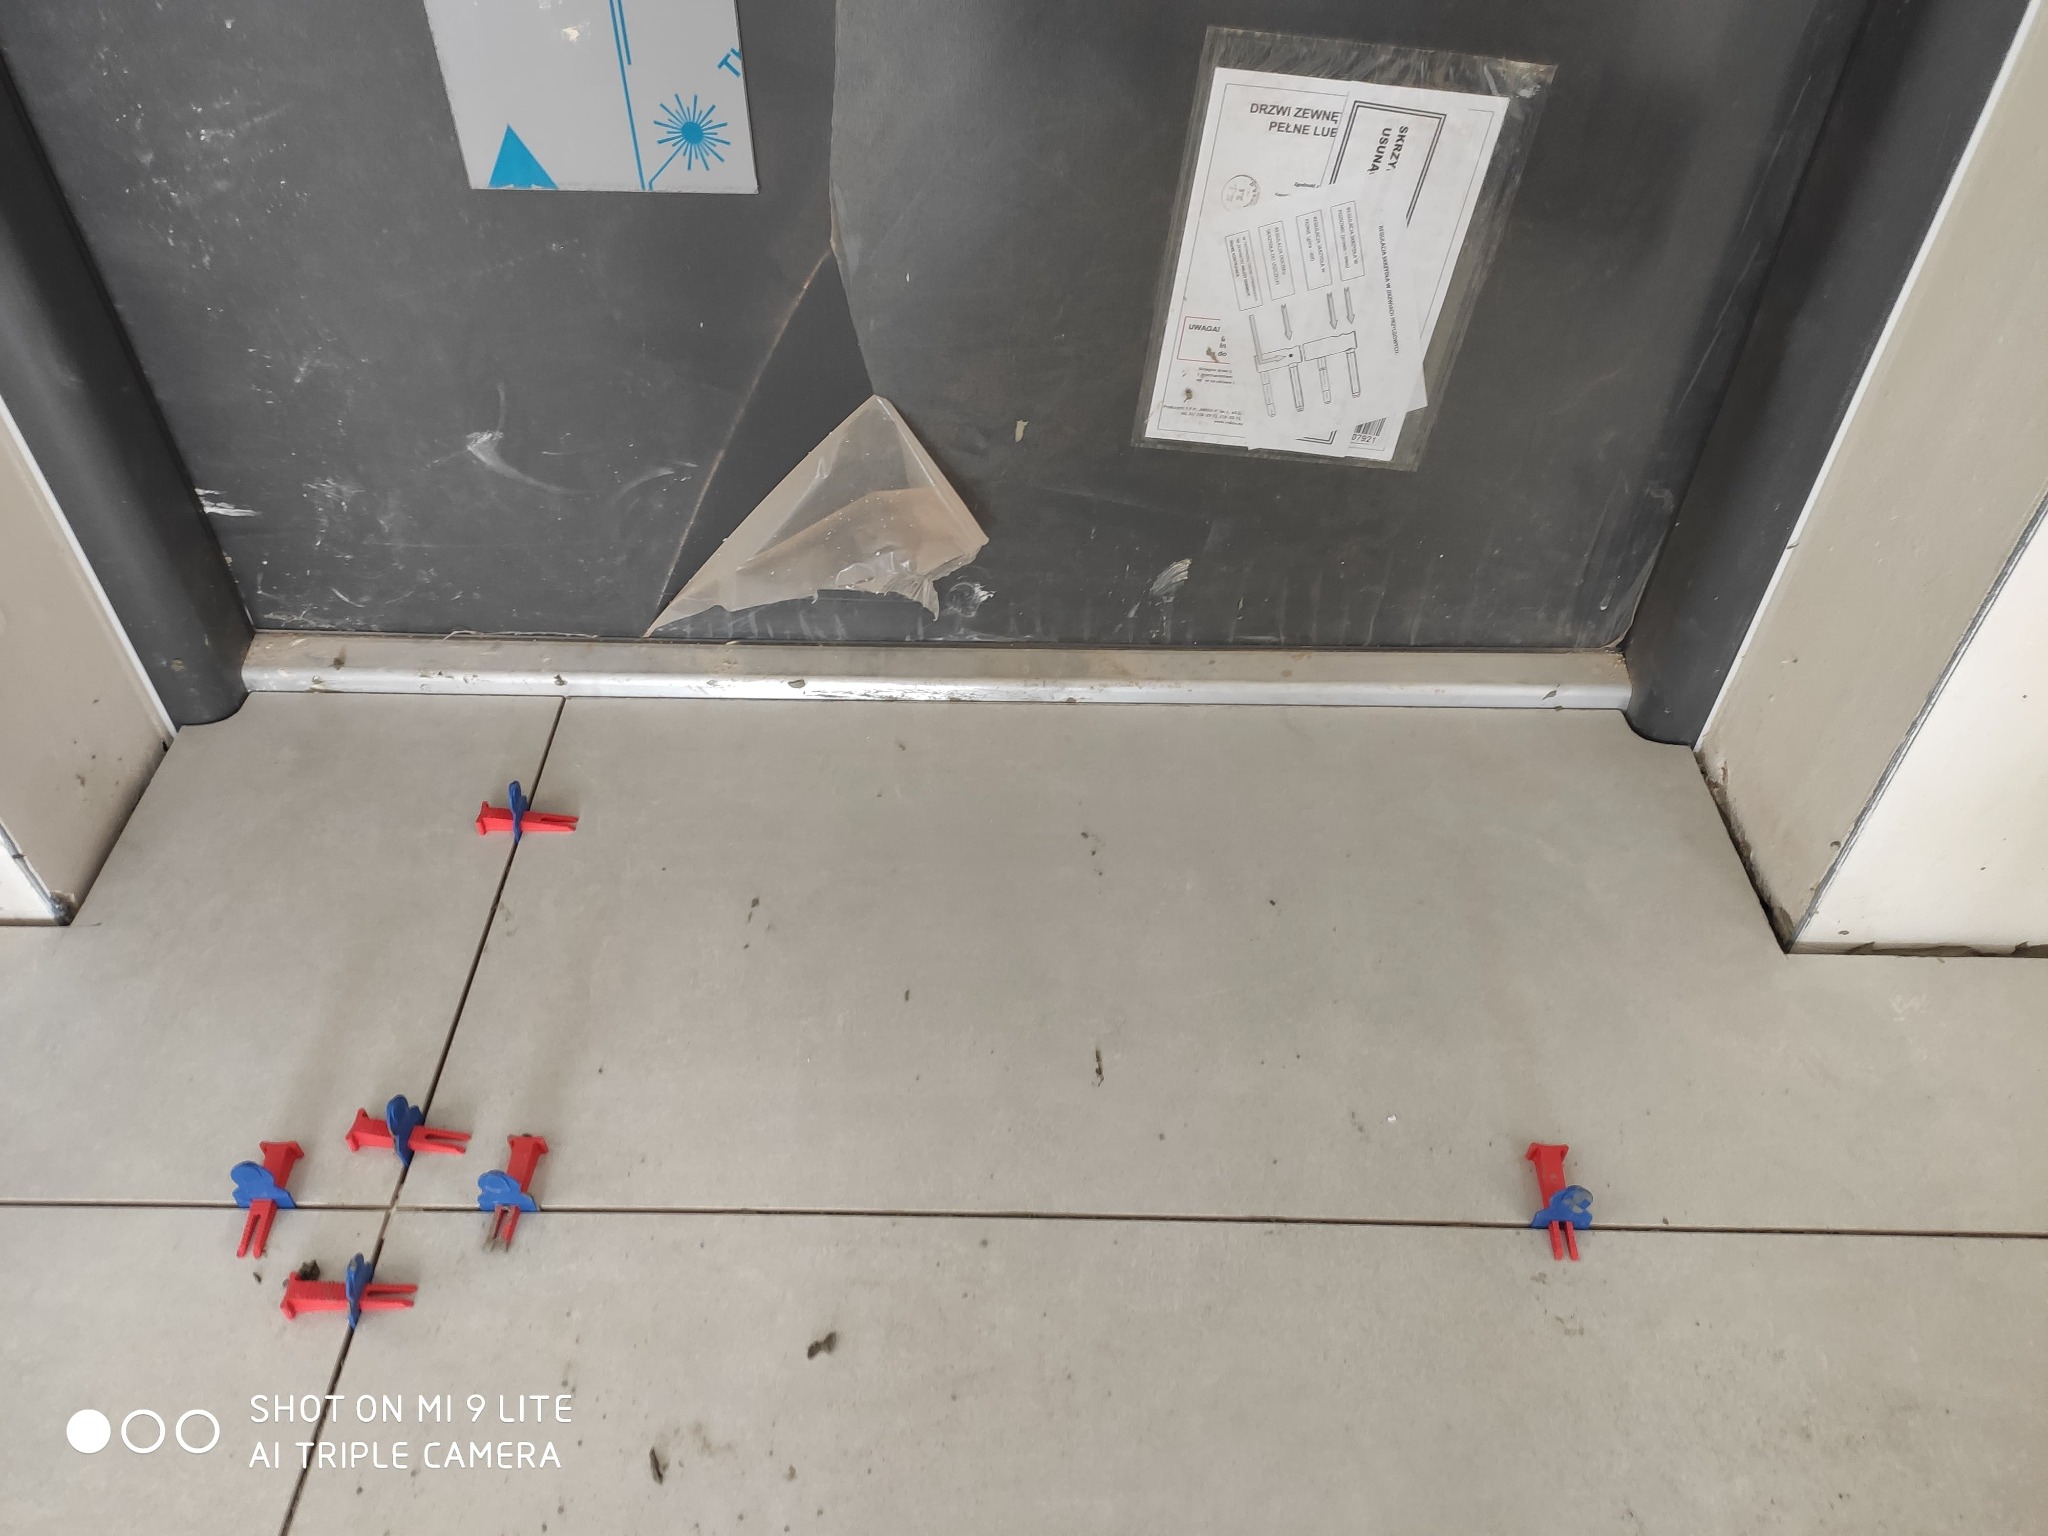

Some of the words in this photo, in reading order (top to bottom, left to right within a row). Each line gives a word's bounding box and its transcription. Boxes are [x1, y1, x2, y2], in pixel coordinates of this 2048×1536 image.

[1250, 103, 1292, 117] DRZWI
[1293, 107, 1342, 124] ZEWNĘ
[1268, 121, 1310, 135] PEŁNE
[1367, 127, 1393, 175] USUNĄ
[1386, 125, 1408, 172] SKRZY
[1188, 324, 1220, 332] UWAGA!
